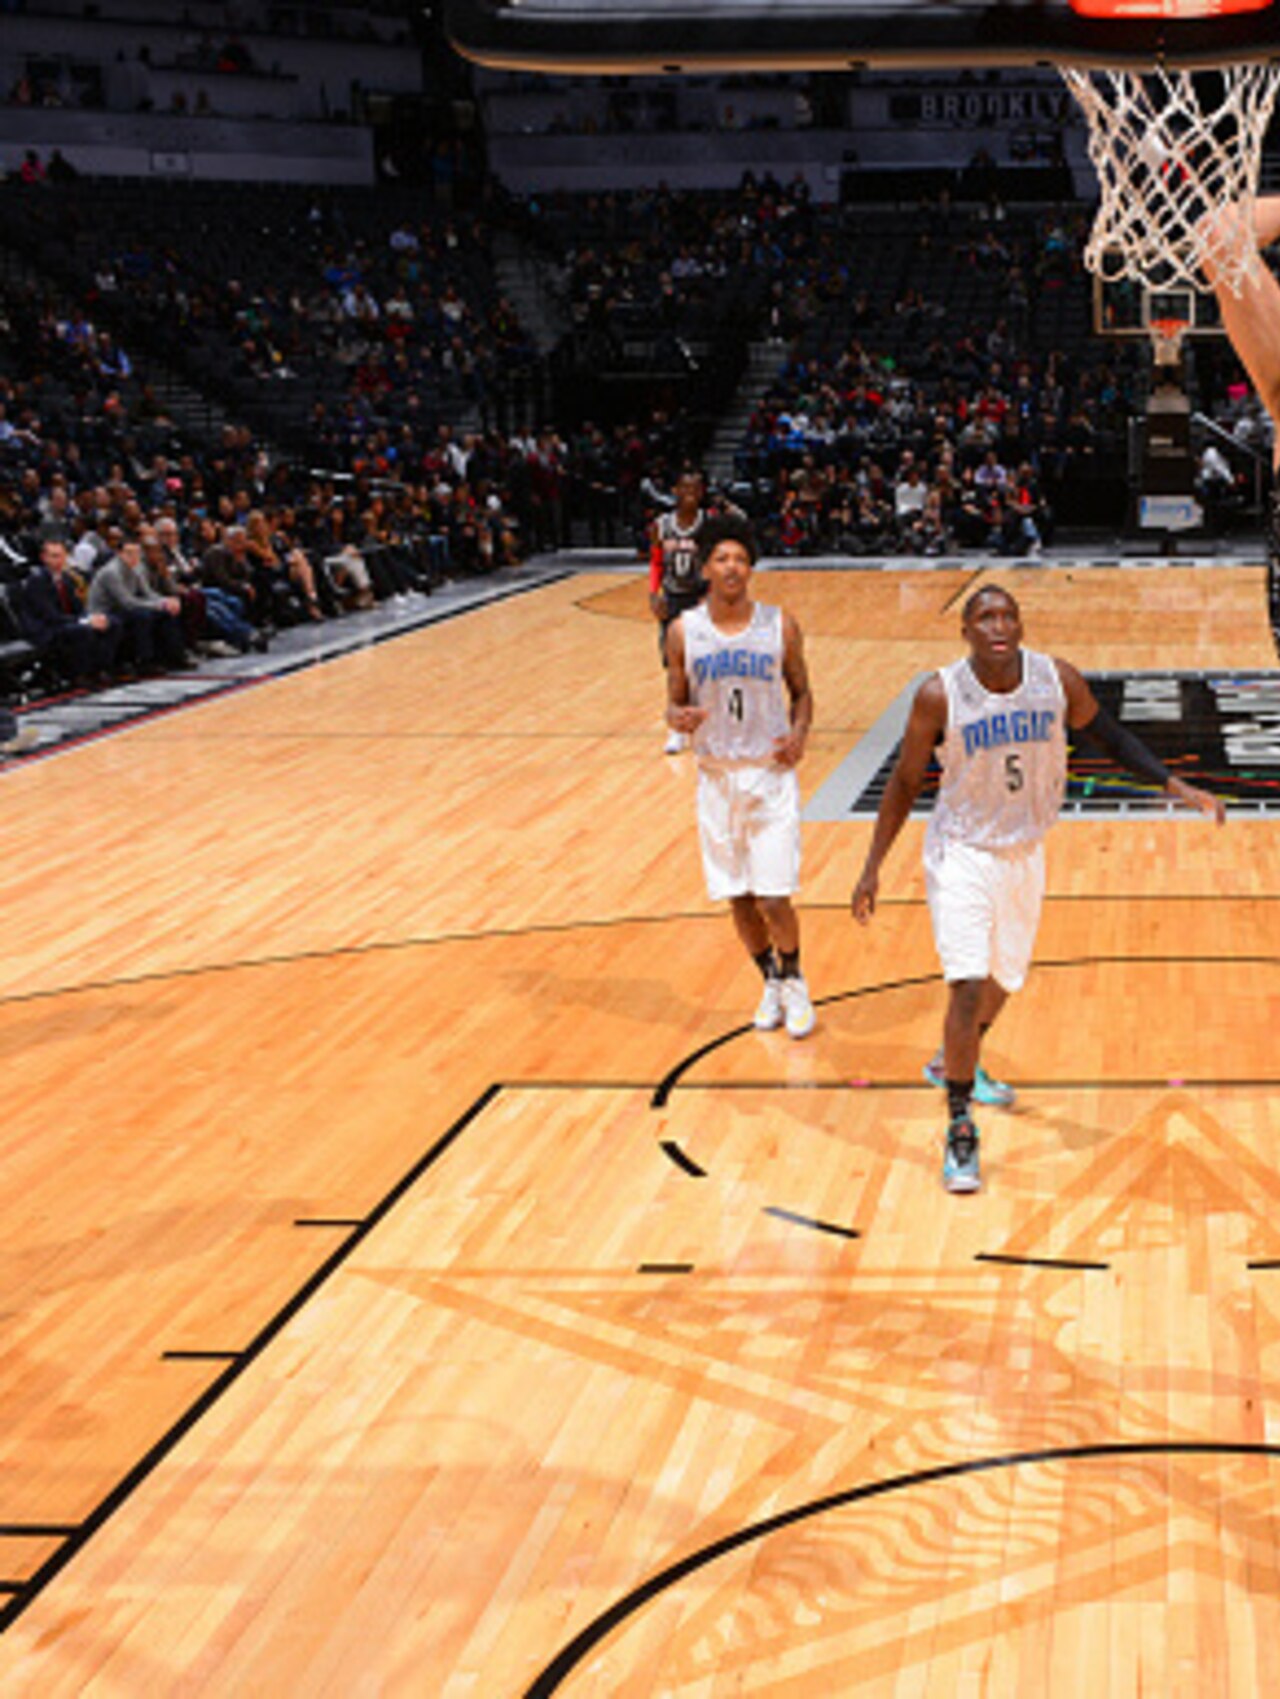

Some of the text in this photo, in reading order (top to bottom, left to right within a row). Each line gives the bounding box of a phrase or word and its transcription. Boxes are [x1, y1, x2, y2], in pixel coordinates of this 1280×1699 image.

[693, 648, 775, 686] MAGIC
[727, 687, 743, 722] 4
[961, 709, 1057, 757] MAGIC
[1004, 754, 1024, 793] 5
